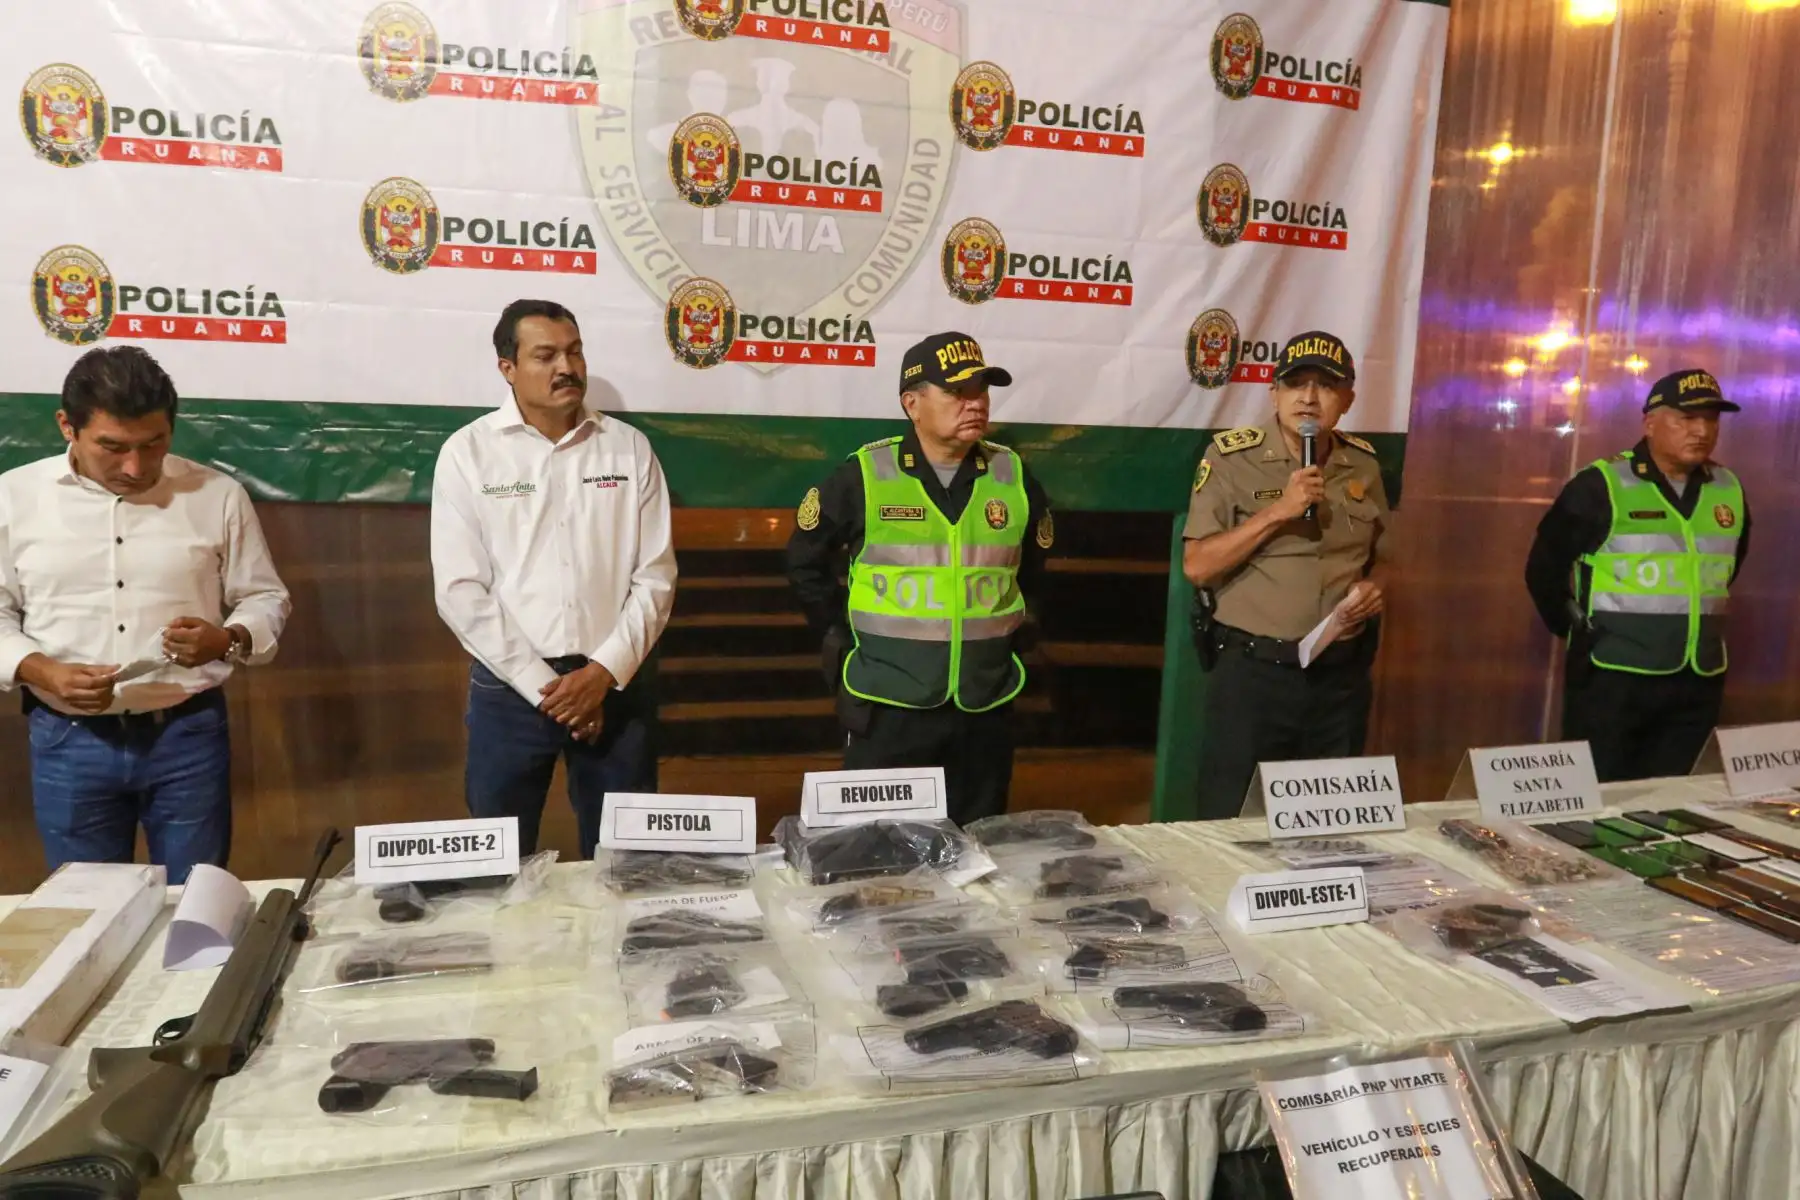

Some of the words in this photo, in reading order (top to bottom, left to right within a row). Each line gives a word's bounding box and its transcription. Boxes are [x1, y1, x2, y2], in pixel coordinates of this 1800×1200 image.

[757, 20, 879, 46] RUANA
[442, 43, 599, 81] POLICÍA
[1264, 51, 1362, 90] POLICÍA
[450, 74, 587, 101] RUANA
[1267, 81, 1355, 104] RUANA
[111, 106, 282, 146] POLICÍA
[1018, 98, 1146, 136] POLICÍA
[121, 141, 271, 166] RUANA
[1023, 129, 1136, 152] RUANA
[743, 152, 883, 189] POLICÍA
[751, 183, 872, 207] RUANA
[842, 137, 941, 308] COMUNIDAD
[1252, 198, 1349, 229] POLICÍA
[443, 216, 598, 250] POLICÍA
[701, 207, 846, 254] LIMA
[1257, 226, 1340, 245] RUANA
[451, 249, 586, 269] RUANA
[1008, 253, 1134, 285] POLICÍA
[118, 284, 286, 319] POLICÍA
[1014, 282, 1125, 300] RUANA
[128, 320, 274, 337] RUANA
[738, 313, 876, 344] POLICÍA
[745, 345, 866, 362] RUANA
[1286, 337, 1344, 365] POLICIA
[1490, 750, 1576, 772] COMISARÍA
[840, 784, 913, 805] REVOLVER
[1269, 769, 1394, 798] COMISARÍA
[1512, 777, 1563, 794] SANTA
[1274, 807, 1350, 830] CANTO
[1354, 803, 1397, 825] REY
[1500, 796, 1585, 817] ELIZABETH
[646, 812, 712, 833] PISTOLA
[377, 833, 496, 859] DIVPOL-ESTE-2
[1255, 883, 1356, 910] DIVPOL-ESTE-1
[1277, 1084, 1361, 1110] COMISARÍA
[1361, 1077, 1387, 1094] PNP
[1390, 1071, 1446, 1091] VITARTE
[1301, 1128, 1380, 1157] VEHÍCULO
[1381, 1127, 1391, 1141] Y
[1395, 1117, 1461, 1139] ESPECIES
[1337, 1144, 1442, 1174] RECUPERADAS
